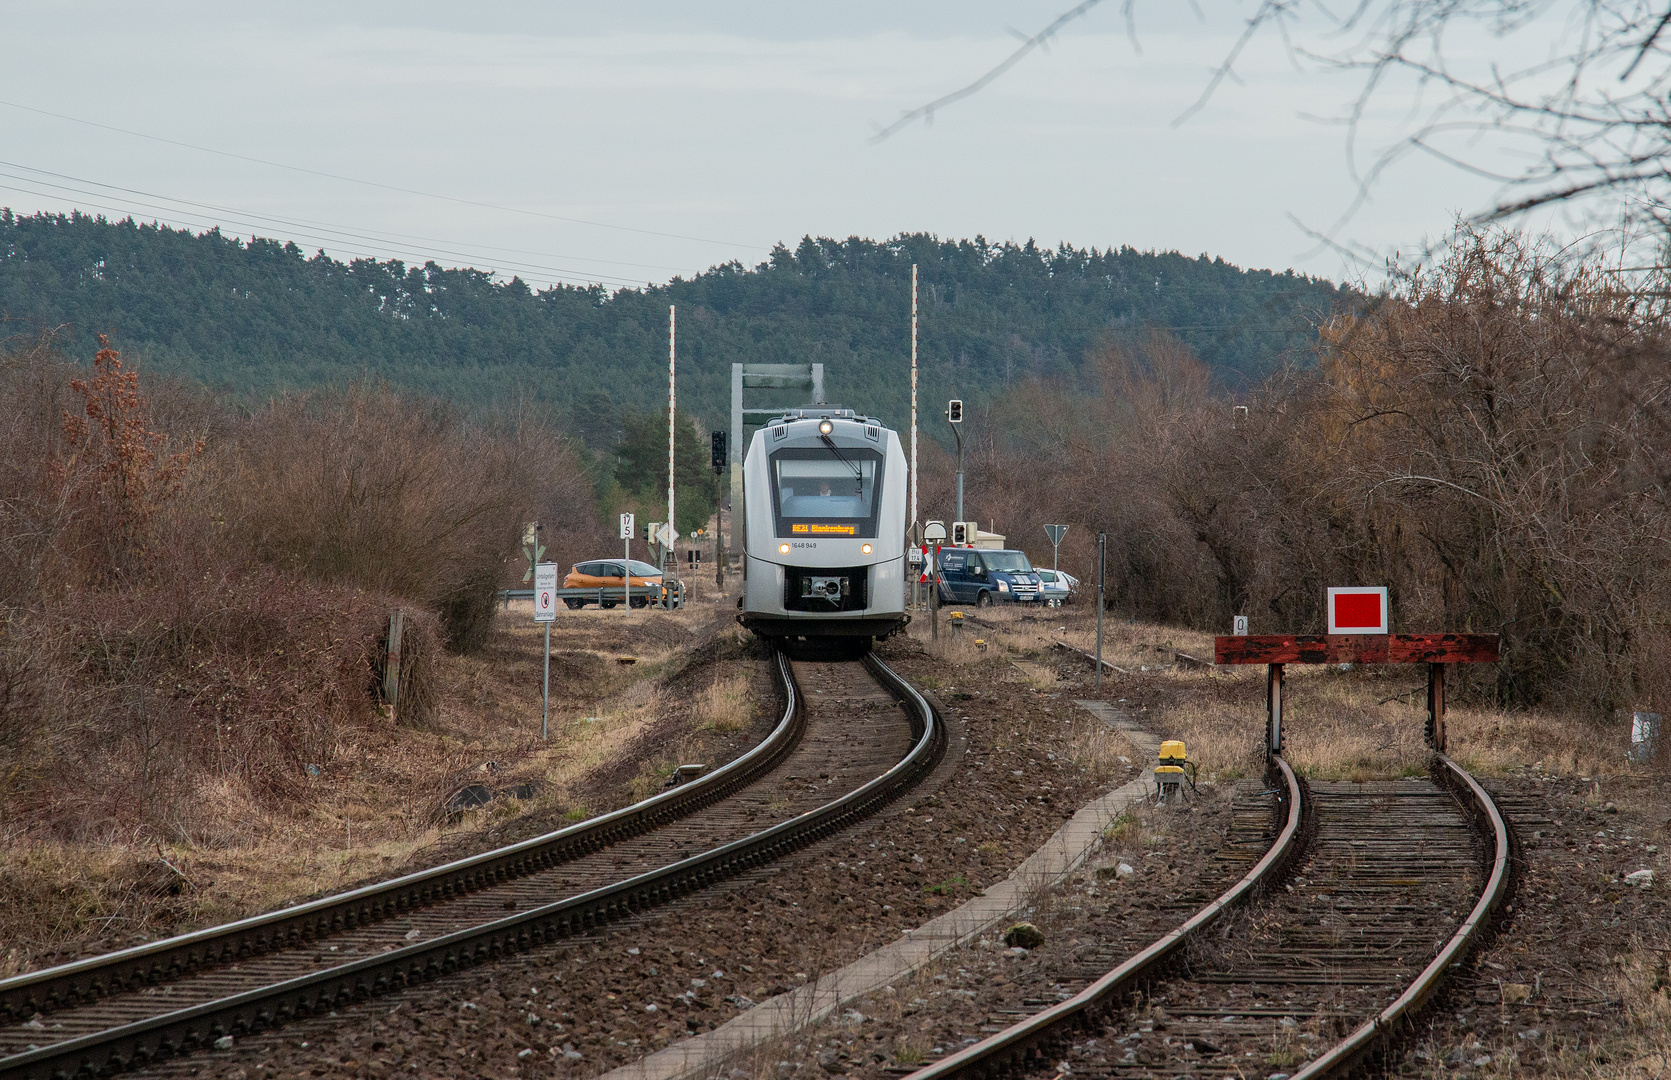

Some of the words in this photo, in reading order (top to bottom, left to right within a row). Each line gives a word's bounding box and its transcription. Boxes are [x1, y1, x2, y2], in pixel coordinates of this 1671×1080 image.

[624, 515, 630, 524] 17
[625, 527, 630, 535] 5
[811, 524, 854, 535] Blankenburg
[1238, 619, 1244, 630] 0
